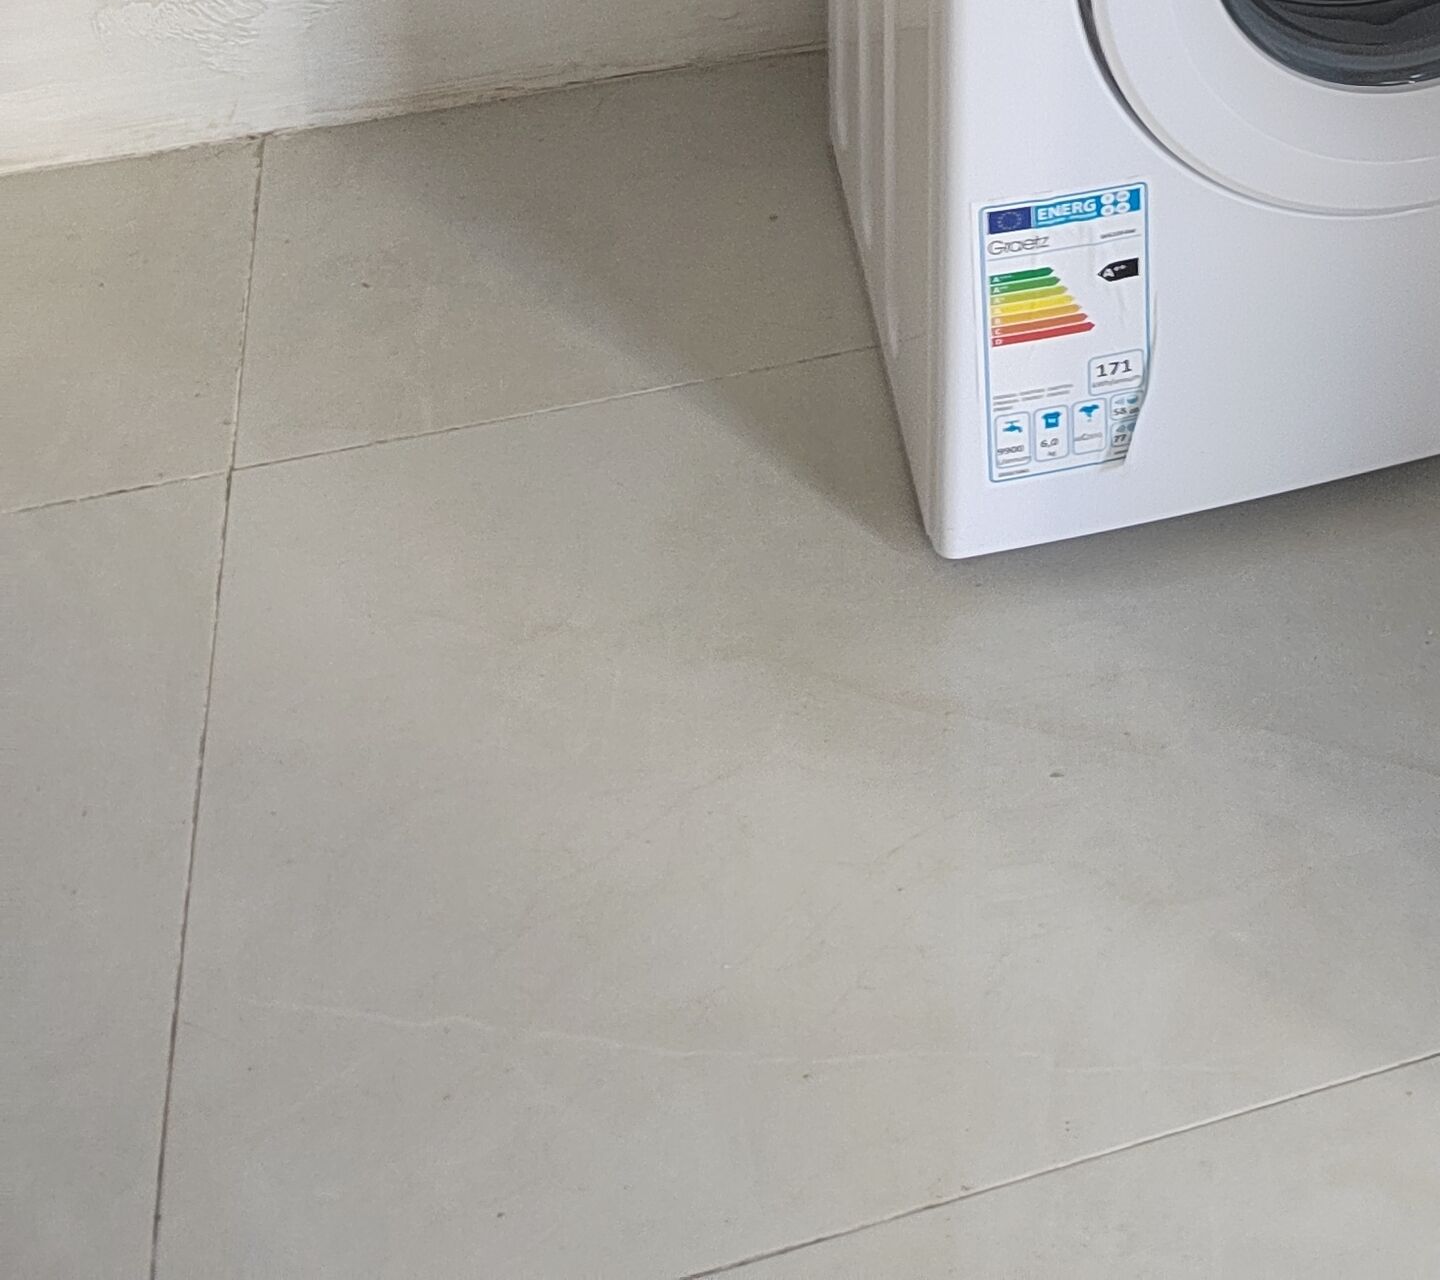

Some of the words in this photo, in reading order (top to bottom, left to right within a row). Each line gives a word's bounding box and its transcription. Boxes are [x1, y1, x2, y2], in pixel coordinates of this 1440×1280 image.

[1037, 198, 1097, 220] ENERG
[988, 235, 1050, 256] Graetz
[1095, 359, 1132, 378] 171
